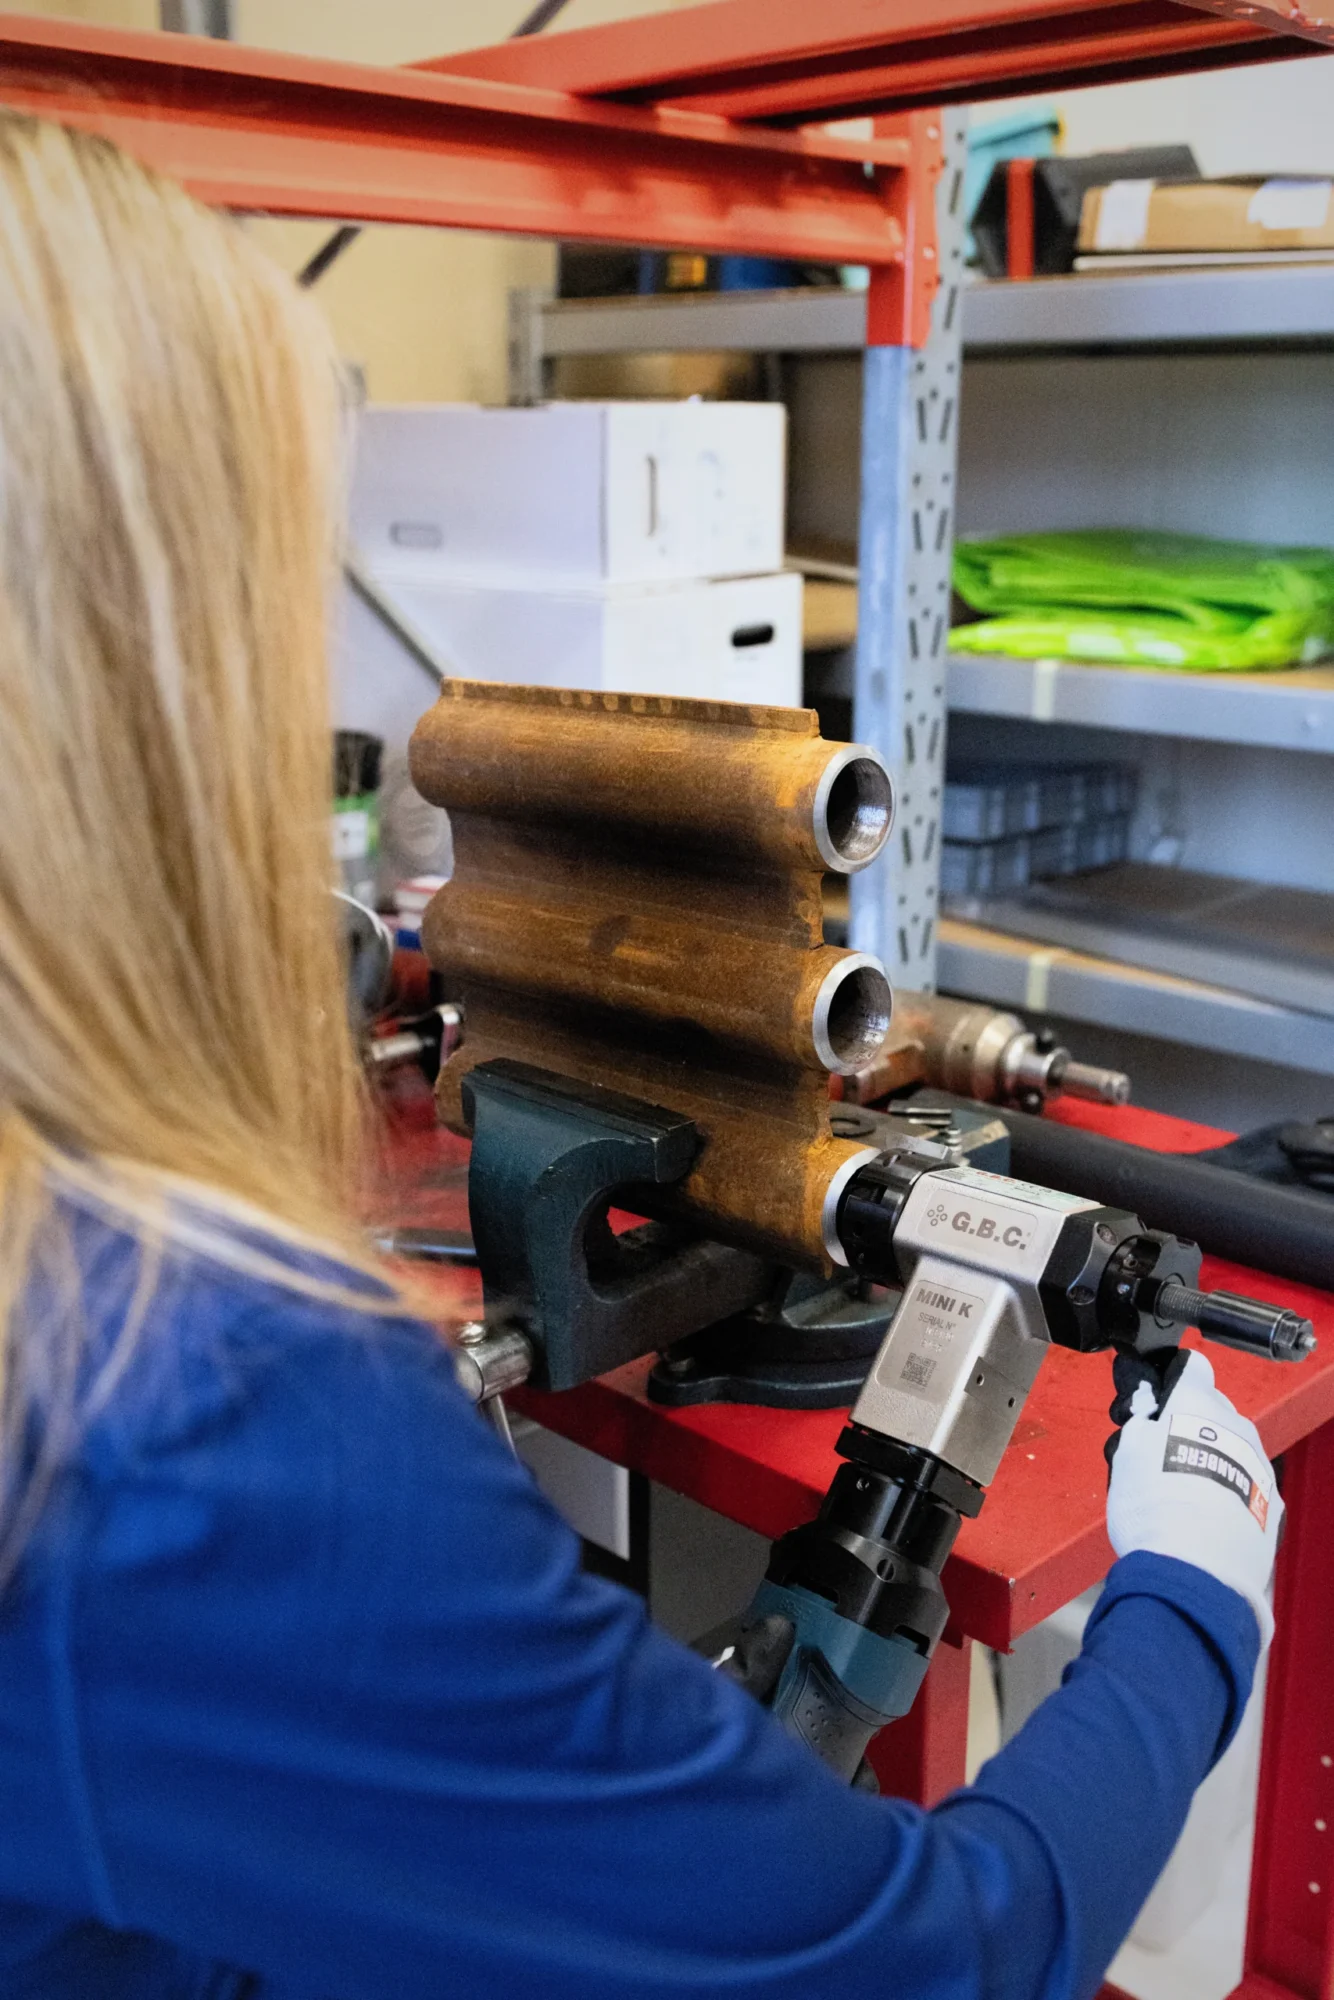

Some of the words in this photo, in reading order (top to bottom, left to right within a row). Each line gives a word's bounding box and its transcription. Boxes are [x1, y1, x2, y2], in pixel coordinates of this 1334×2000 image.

[952, 1211, 1027, 1250] G.B.C.
[916, 1288, 957, 1313] MINI
[957, 1302, 973, 1319] K
[917, 1312, 944, 1329] SERIAL
